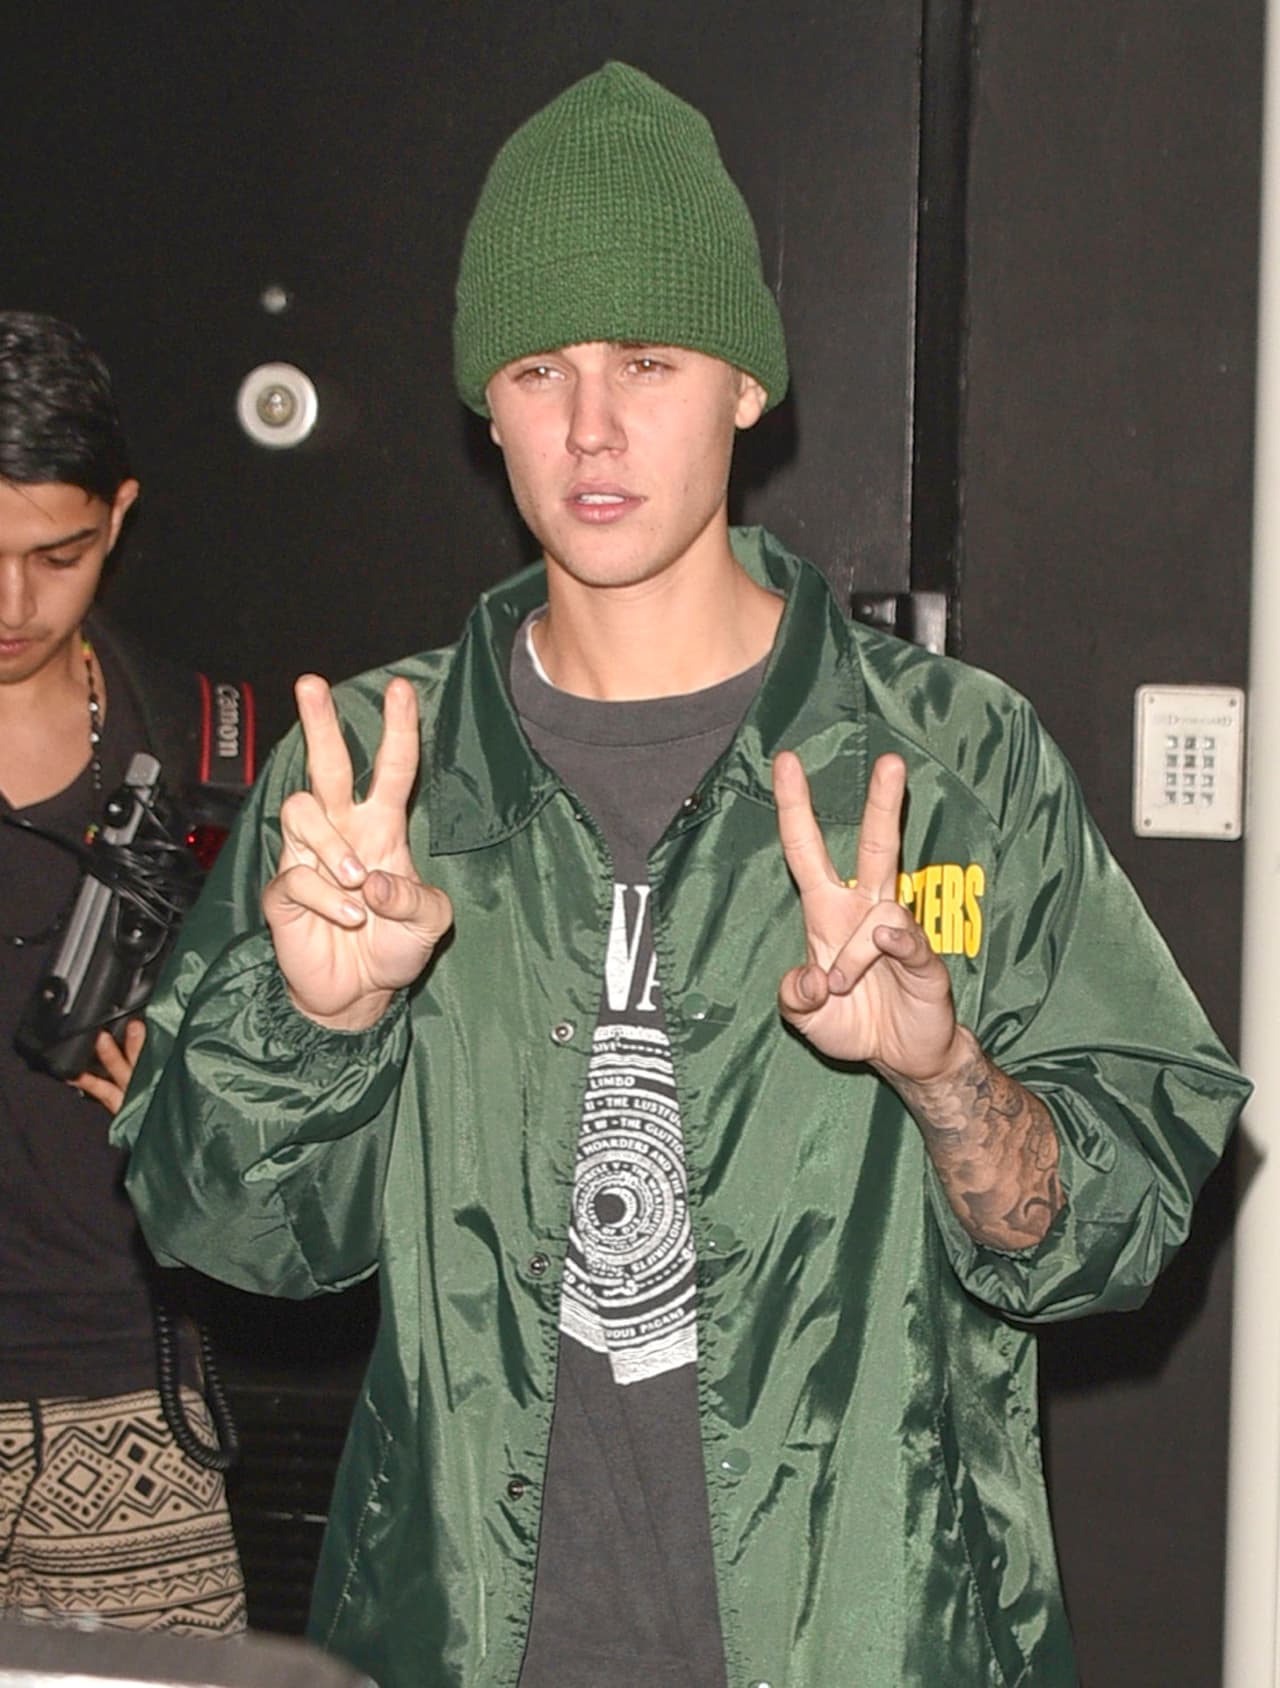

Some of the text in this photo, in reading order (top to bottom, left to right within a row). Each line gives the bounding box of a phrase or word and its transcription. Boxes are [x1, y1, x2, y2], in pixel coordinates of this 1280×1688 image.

[216, 685, 240, 757] Canon
[590, 1076, 635, 1089] LIMBO
[605, 1097, 630, 1108] THE
[620, 1117, 641, 1129] THE
[582, 1138, 650, 1155] HOARDERS
[649, 1150, 672, 1172] AND
[668, 1171, 684, 1195] THE
[640, 1307, 685, 1334] PAGANS
